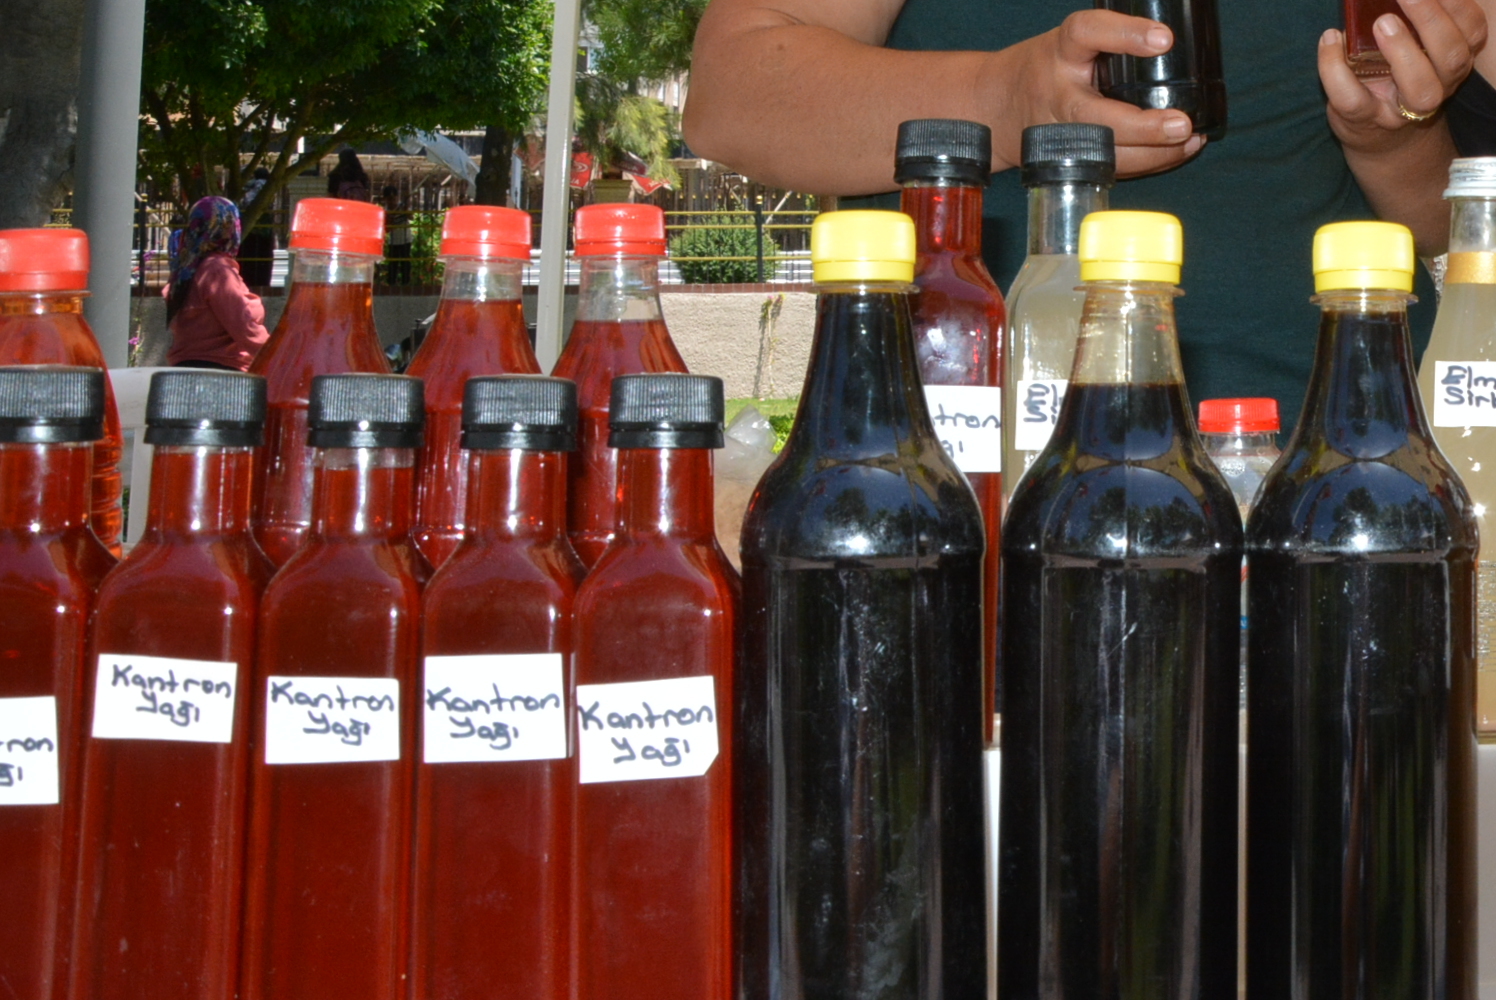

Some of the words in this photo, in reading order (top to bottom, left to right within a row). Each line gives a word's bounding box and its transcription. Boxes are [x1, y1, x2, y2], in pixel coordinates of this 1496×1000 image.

[932, 403, 1001, 428] tron
[111, 664, 232, 698] Kantron
[271, 680, 395, 712] Kantron
[426, 682, 560, 715] Kantron
[577, 701, 713, 731] Kantron
